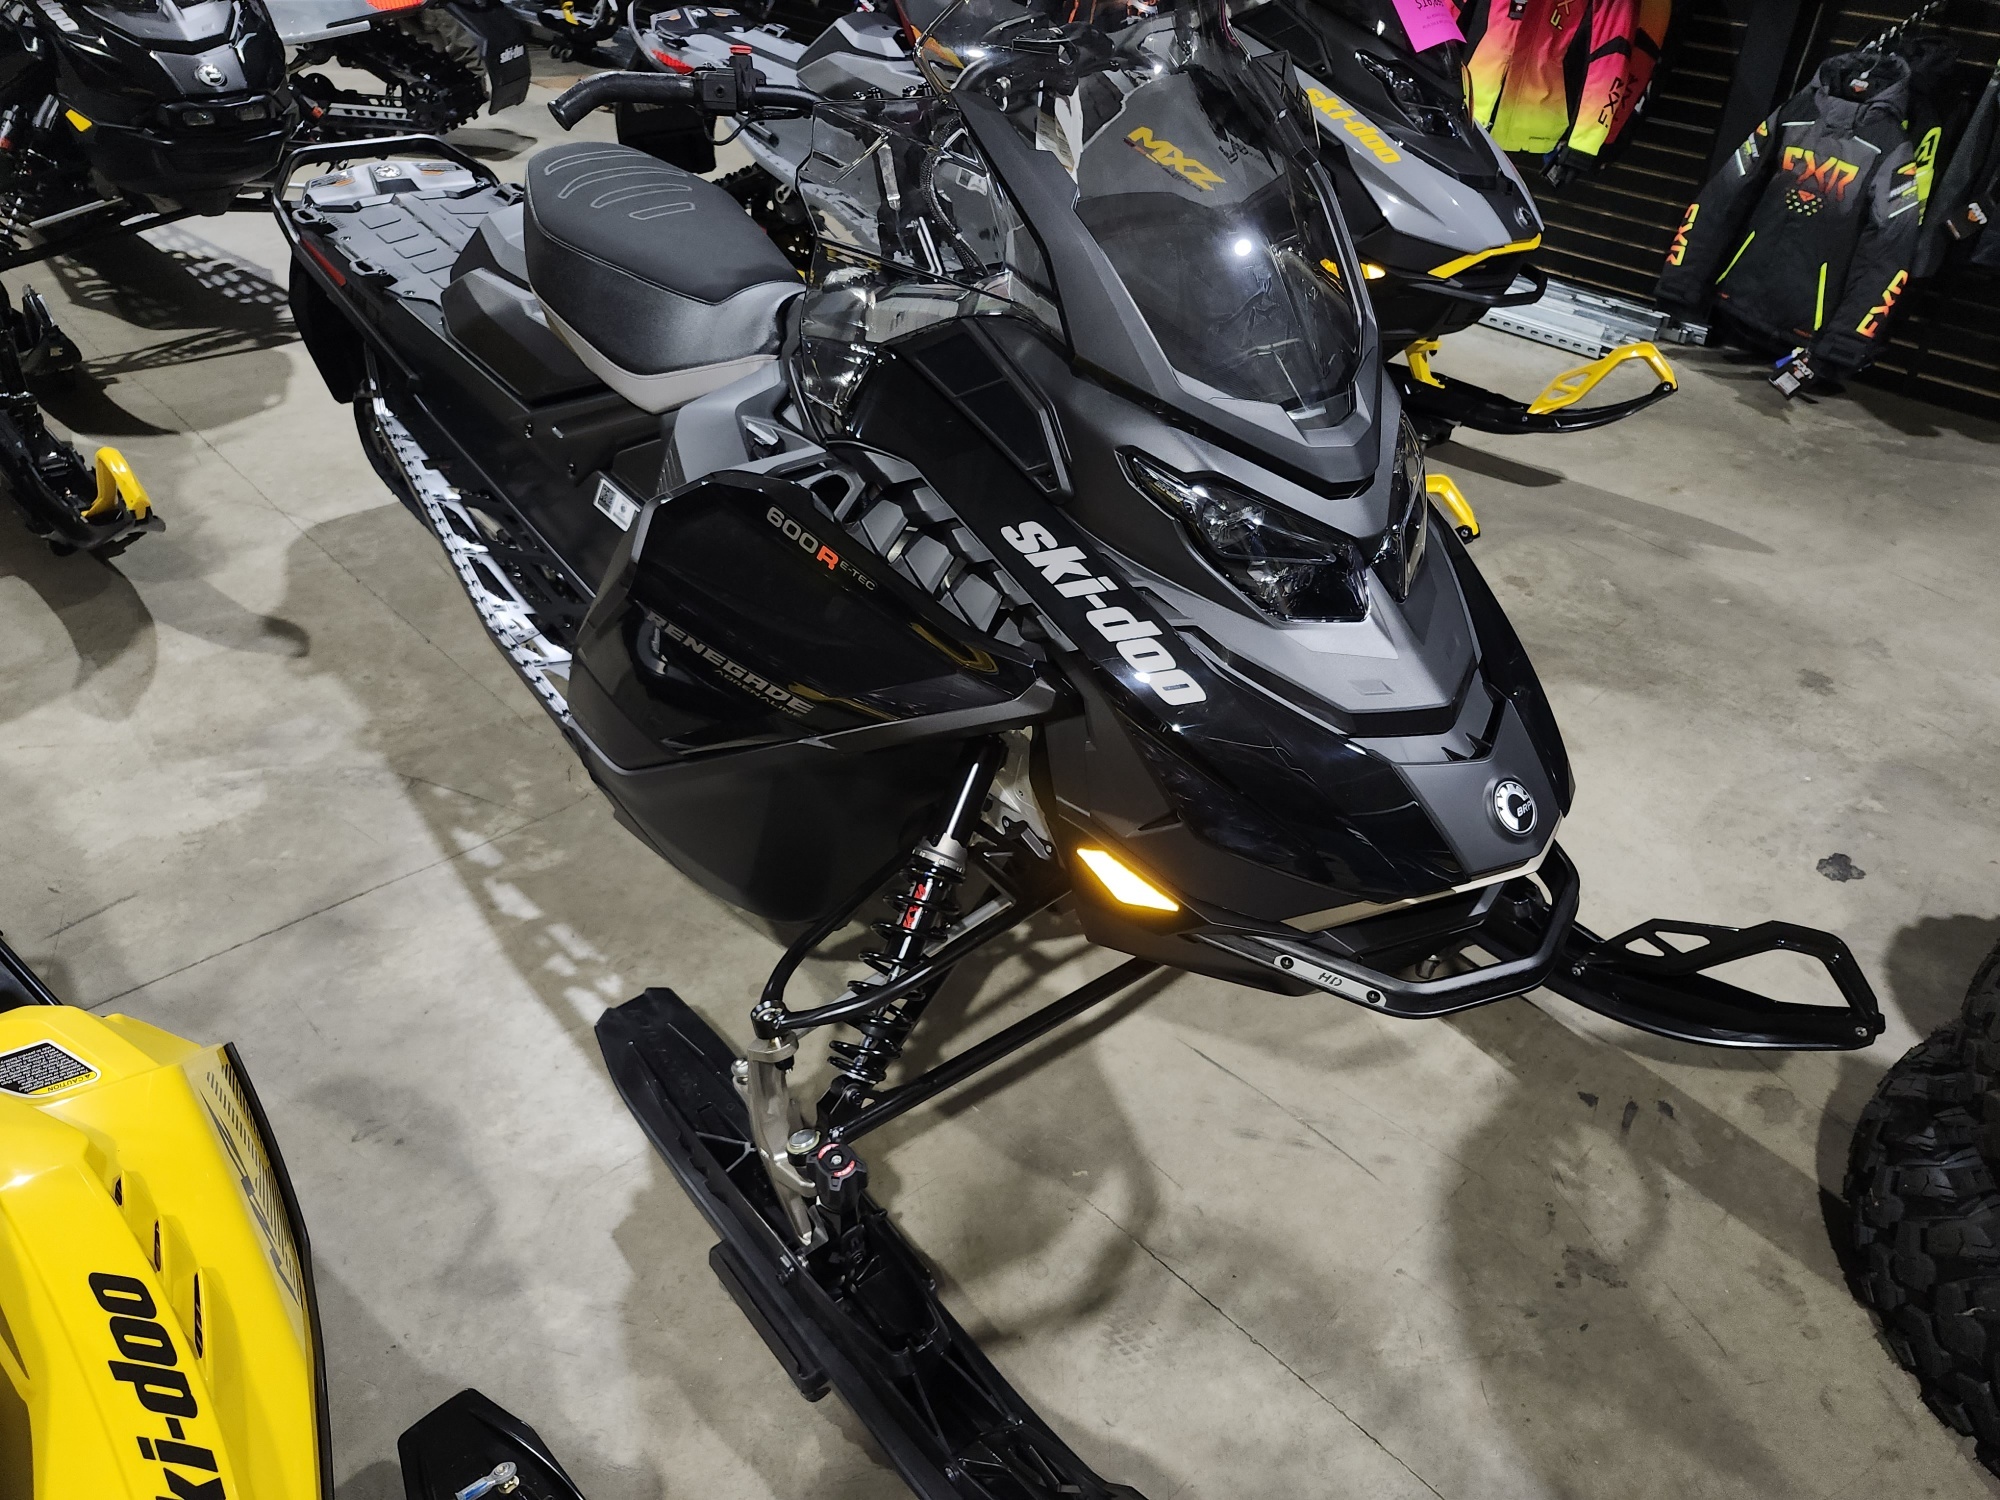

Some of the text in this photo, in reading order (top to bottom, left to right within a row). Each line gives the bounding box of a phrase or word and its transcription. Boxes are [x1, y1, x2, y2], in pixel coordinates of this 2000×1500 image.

[1306, 88, 1401, 164] ski-doo
[1597, 76, 1625, 128] FXR
[1127, 126, 1227, 191] MXZ
[1782, 146, 1860, 201] FXR
[1856, 269, 1909, 339] FXR
[766, 506, 876, 591] 600R E-TEC
[1000, 520, 1207, 706] ski-doo
[646, 610, 815, 714] RENEGADE
[714, 669, 804, 717] ADRENALINE
[1516, 800, 1532, 818] BRP
[1318, 972, 1343, 987] HD
[47, 1077, 84, 1091] CAUTION
